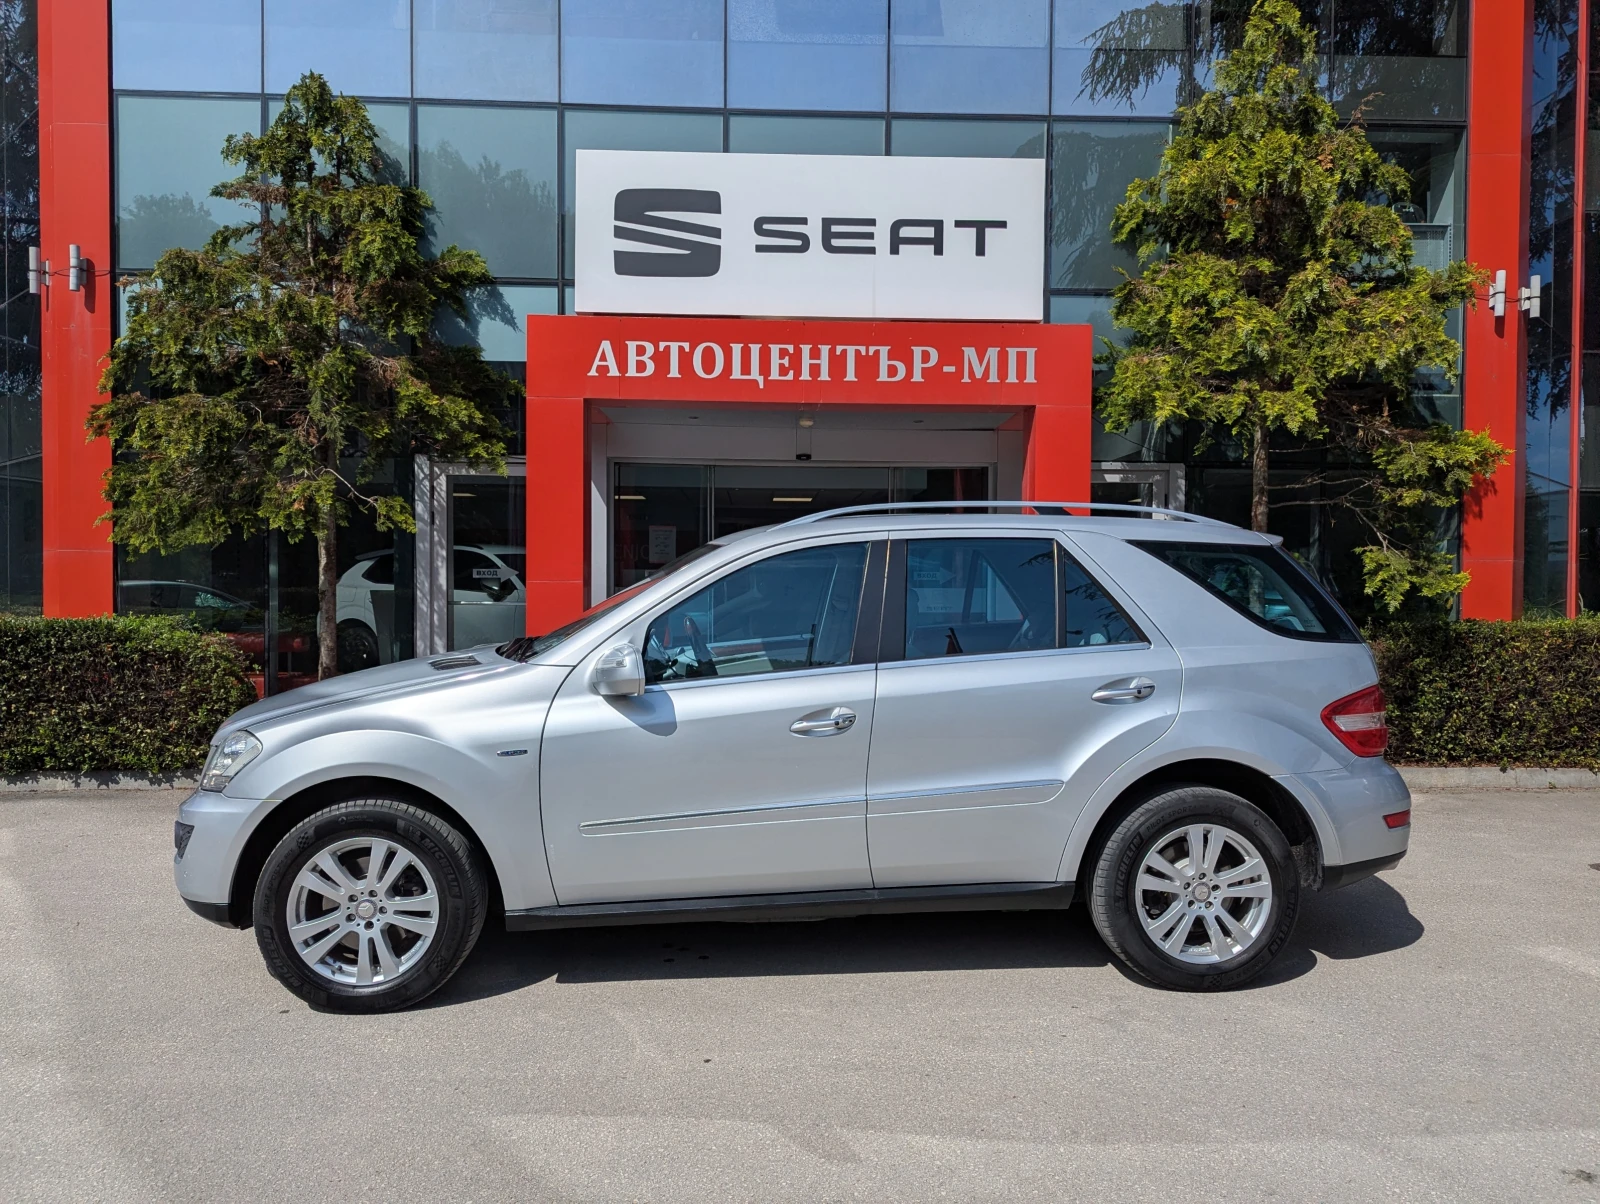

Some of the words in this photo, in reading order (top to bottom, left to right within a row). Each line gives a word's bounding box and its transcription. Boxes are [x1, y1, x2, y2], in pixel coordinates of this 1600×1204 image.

[754, 216, 1007, 257] SEAT
[587, 339, 1038, 389] АВТОЦЕНТЪР-МП
[1146, 816, 1165, 833] PILOT
[1167, 805, 1194, 819] SPORT
[421, 838, 463, 899] MICHELIN
[1114, 835, 1142, 899] MICHELIN
[262, 926, 302, 988] MICHELIN
